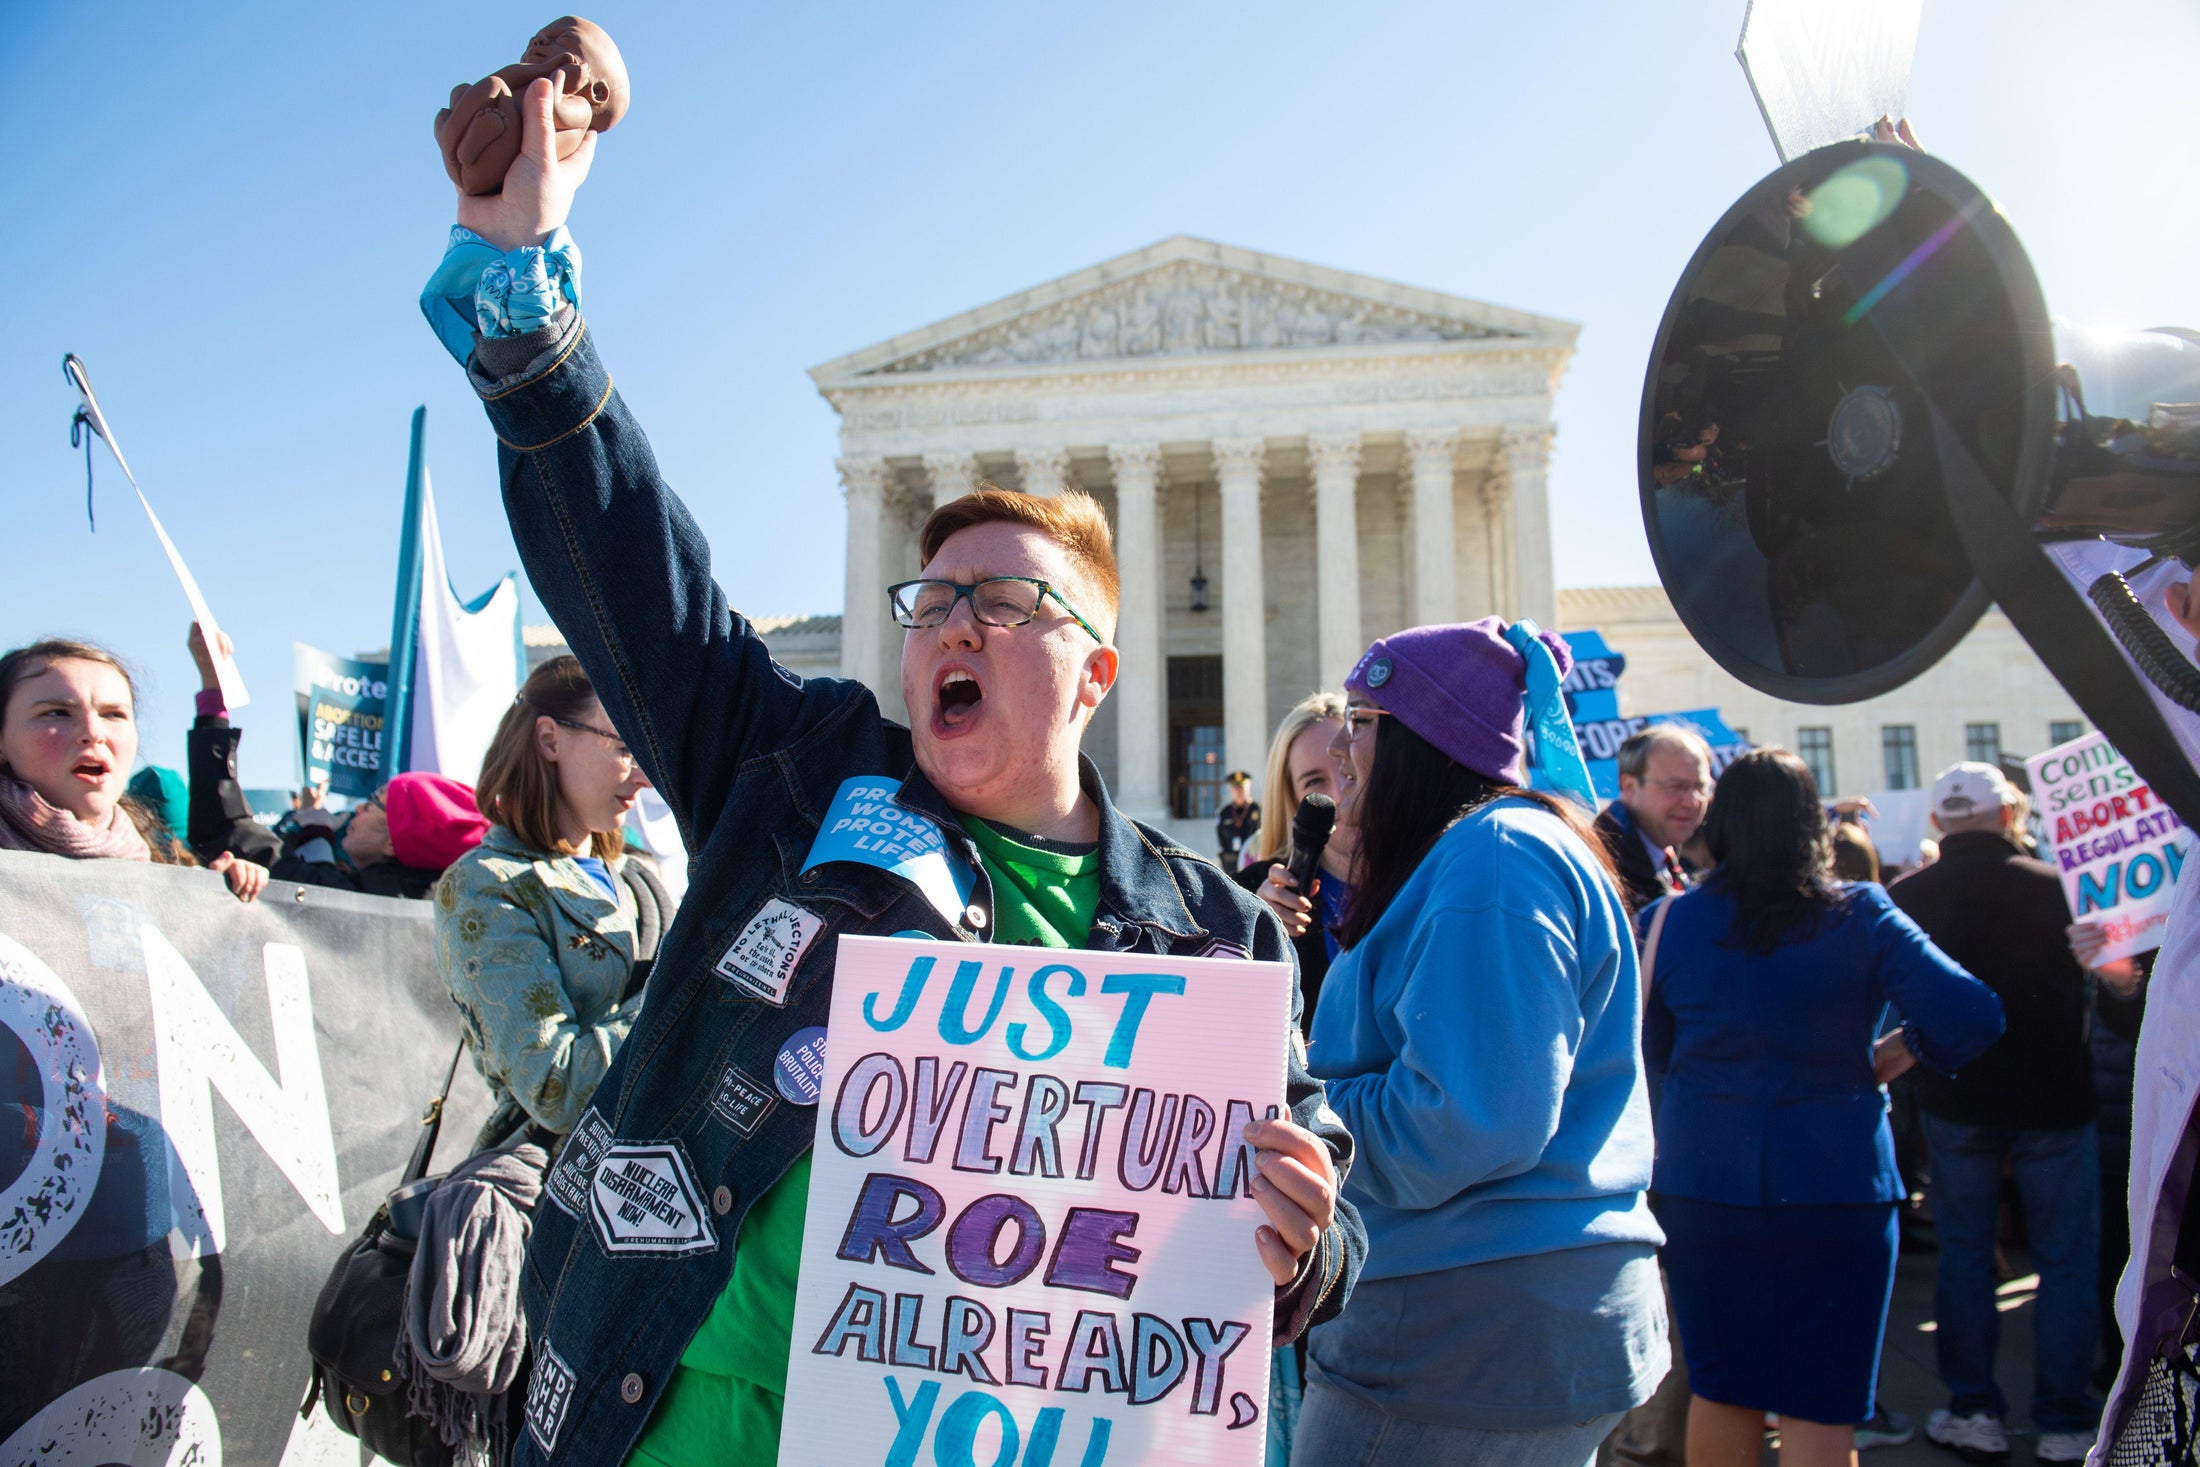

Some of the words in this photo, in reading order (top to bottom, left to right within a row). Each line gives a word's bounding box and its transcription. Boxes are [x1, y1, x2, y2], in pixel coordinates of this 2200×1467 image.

[830, 818, 934, 855] PROTE
[2056, 785, 2163, 844] ABORT
[732, 938, 748, 955] NO
[747, 910, 788, 935] LETHAL
[862, 955, 1187, 1069] JUST
[779, 1049, 820, 1099] BRUTALITY
[796, 1045, 824, 1080] POLICE
[831, 1052, 1279, 1200] OVERTURN
[599, 1166, 687, 1230] DISARMAMENT
[621, 1160, 679, 1203] NUCLEAR
[616, 1200, 648, 1228] NOW!
[836, 1172, 1141, 1300] ROE
[812, 1281, 1259, 1430] ALREADY,
[883, 1375, 1113, 1467] YOU
